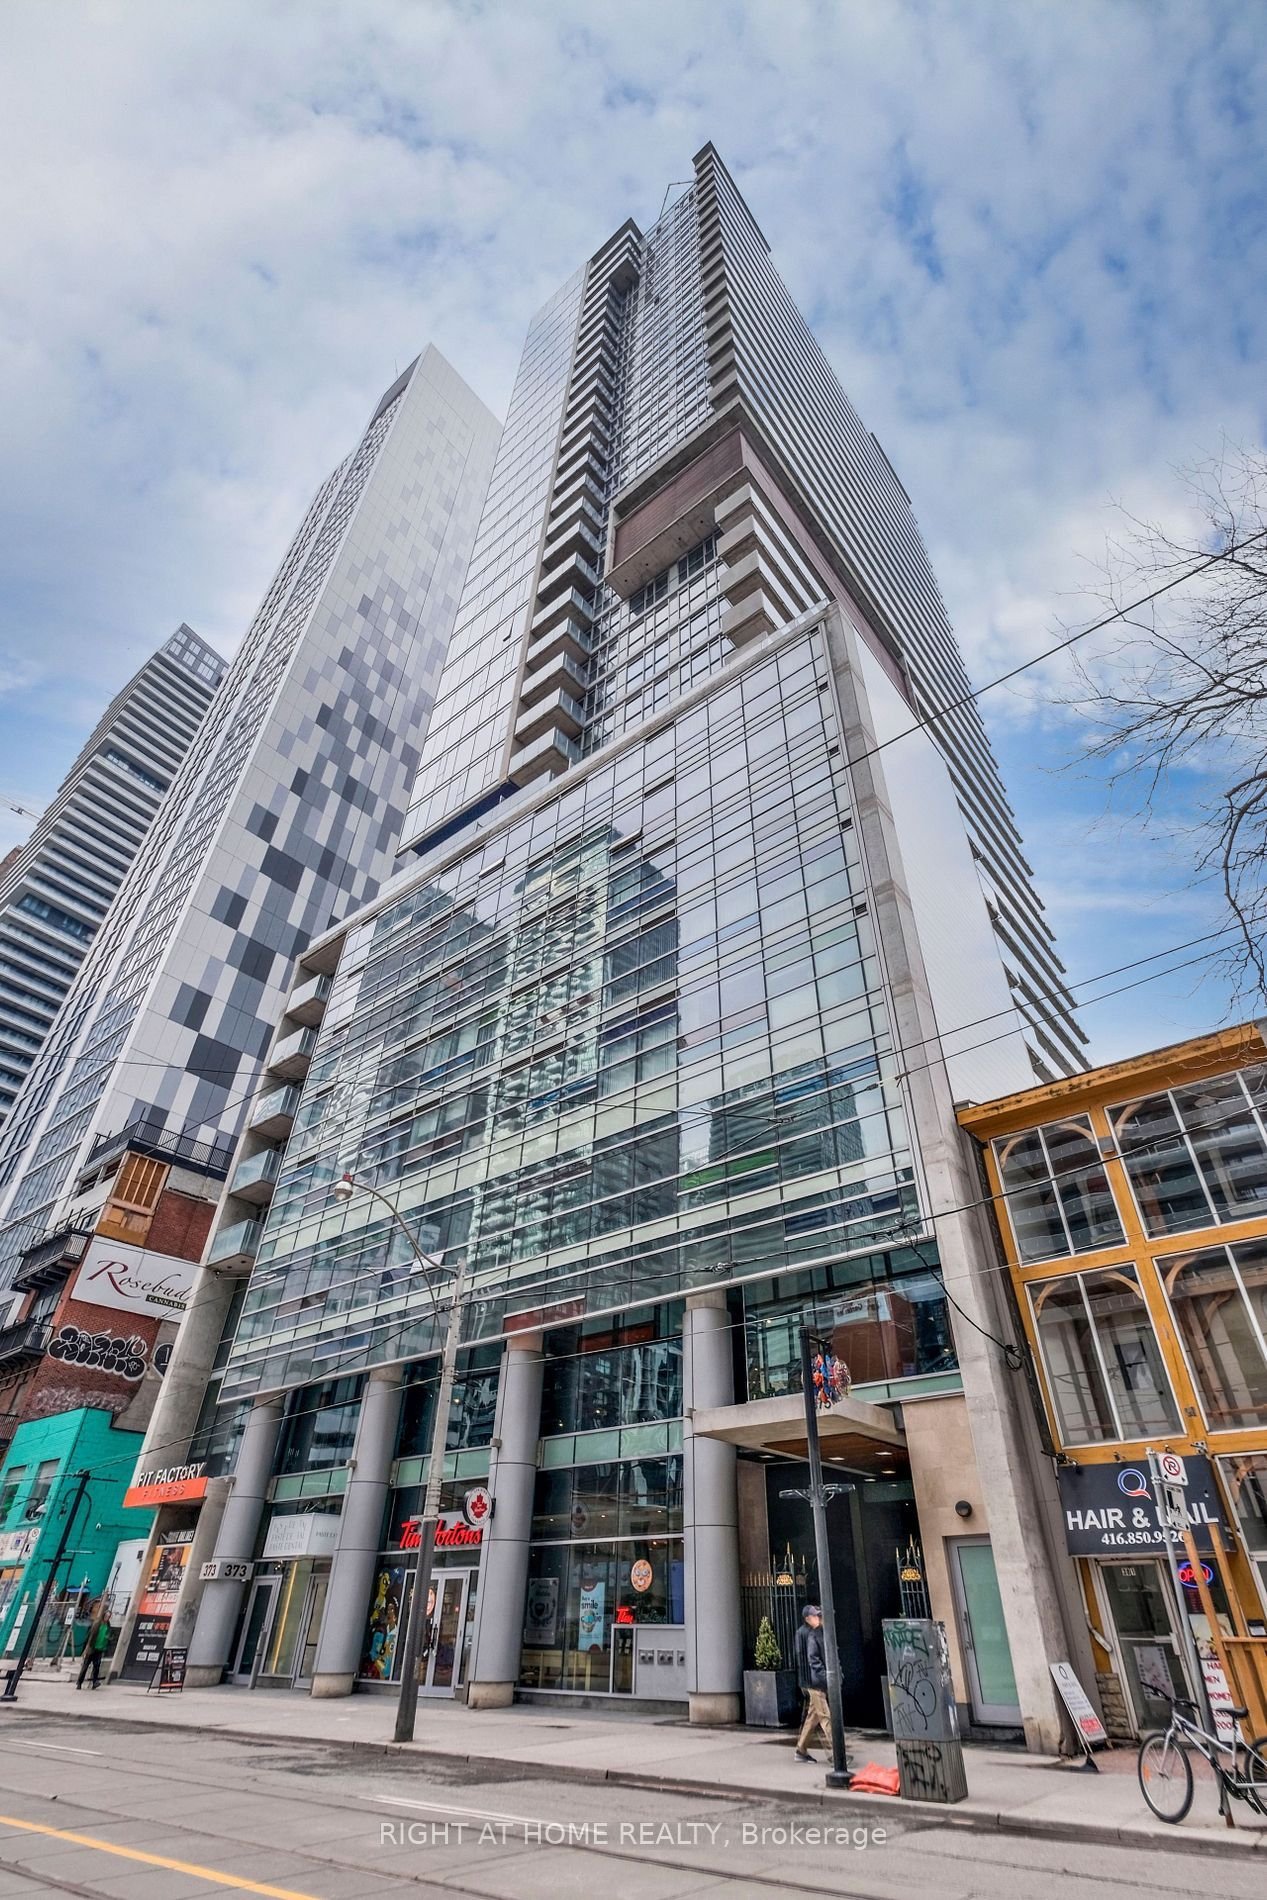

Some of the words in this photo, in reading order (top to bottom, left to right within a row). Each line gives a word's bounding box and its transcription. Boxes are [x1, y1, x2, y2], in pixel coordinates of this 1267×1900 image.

[87, 1260, 192, 1302] Rosebud
[149, 1295, 186, 1310] CANNABIS
[137, 1470, 154, 1488] FIT
[154, 1462, 207, 1485] FACTORY
[1066, 1508, 1126, 1531] HAIR
[1132, 1507, 1151, 1529] &
[203, 1564, 217, 1577] 373
[224, 1564, 248, 1577] 373
[1178, 1568, 1209, 1582] OPN
[581, 1600, 599, 1609] smile
